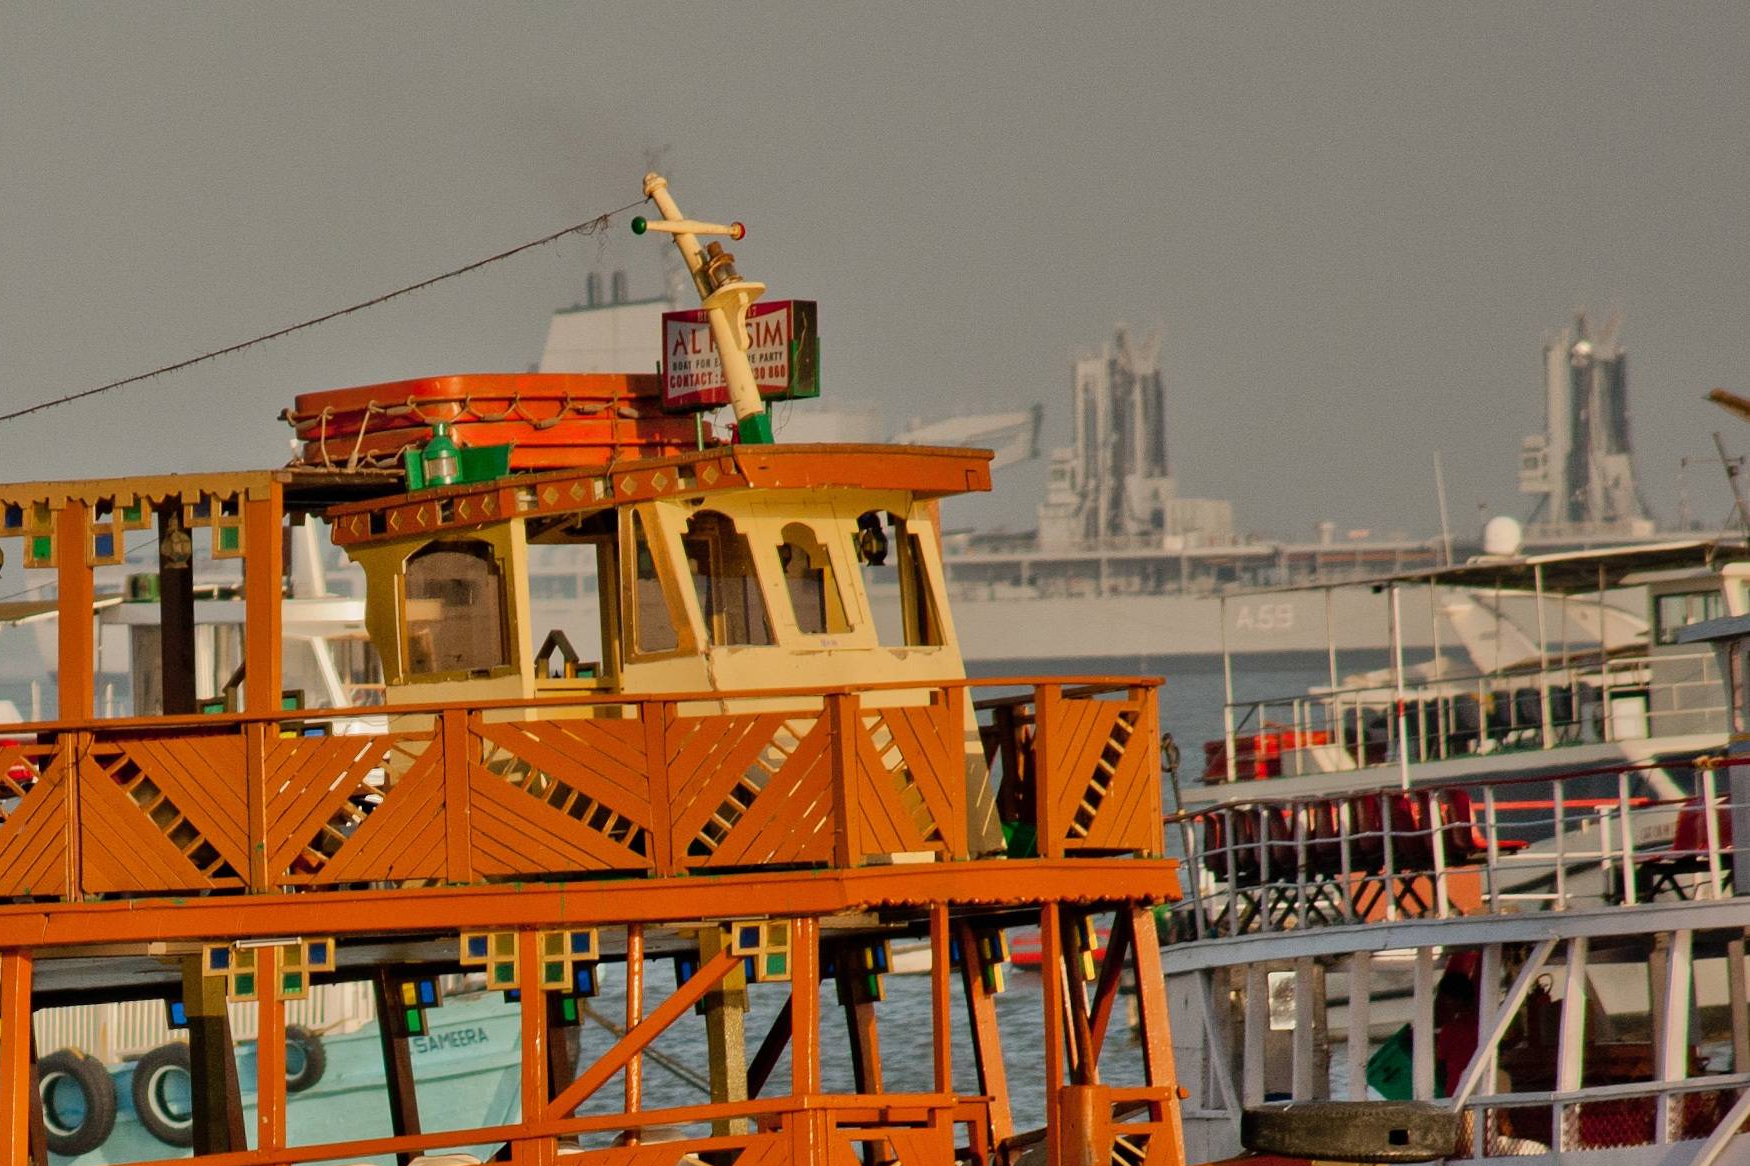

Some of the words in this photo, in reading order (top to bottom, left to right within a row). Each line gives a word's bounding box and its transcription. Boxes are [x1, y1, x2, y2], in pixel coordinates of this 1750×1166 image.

[673, 329, 701, 355] AL
[673, 361, 691, 371] BOAT
[696, 359, 711, 369] FOR
[759, 351, 783, 362] PARTY
[413, 1027, 489, 1053] SAMEERA
